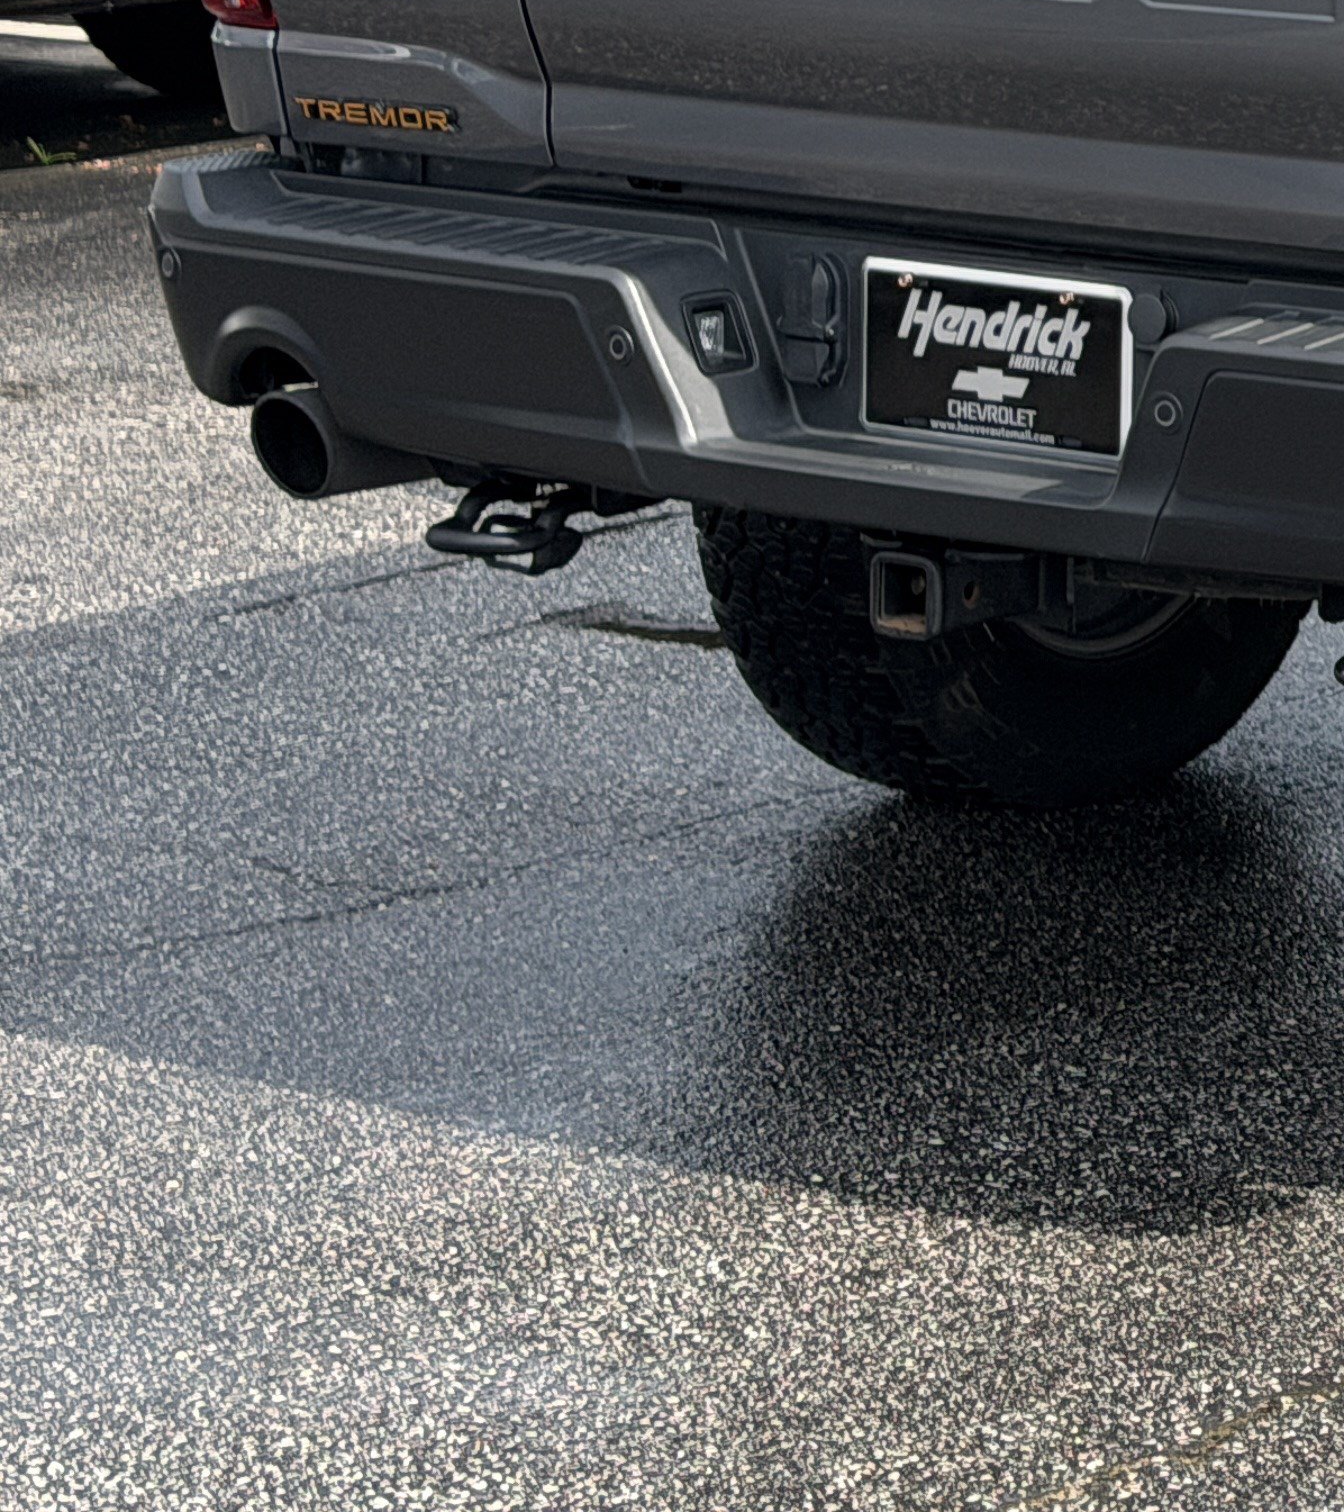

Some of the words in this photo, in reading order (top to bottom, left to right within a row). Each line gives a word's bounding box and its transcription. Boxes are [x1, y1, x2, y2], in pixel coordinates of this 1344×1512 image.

[294, 97, 455, 134] TREMOR
[897, 288, 1091, 360] Hendrick
[946, 398, 1037, 429] CHEVROLET
